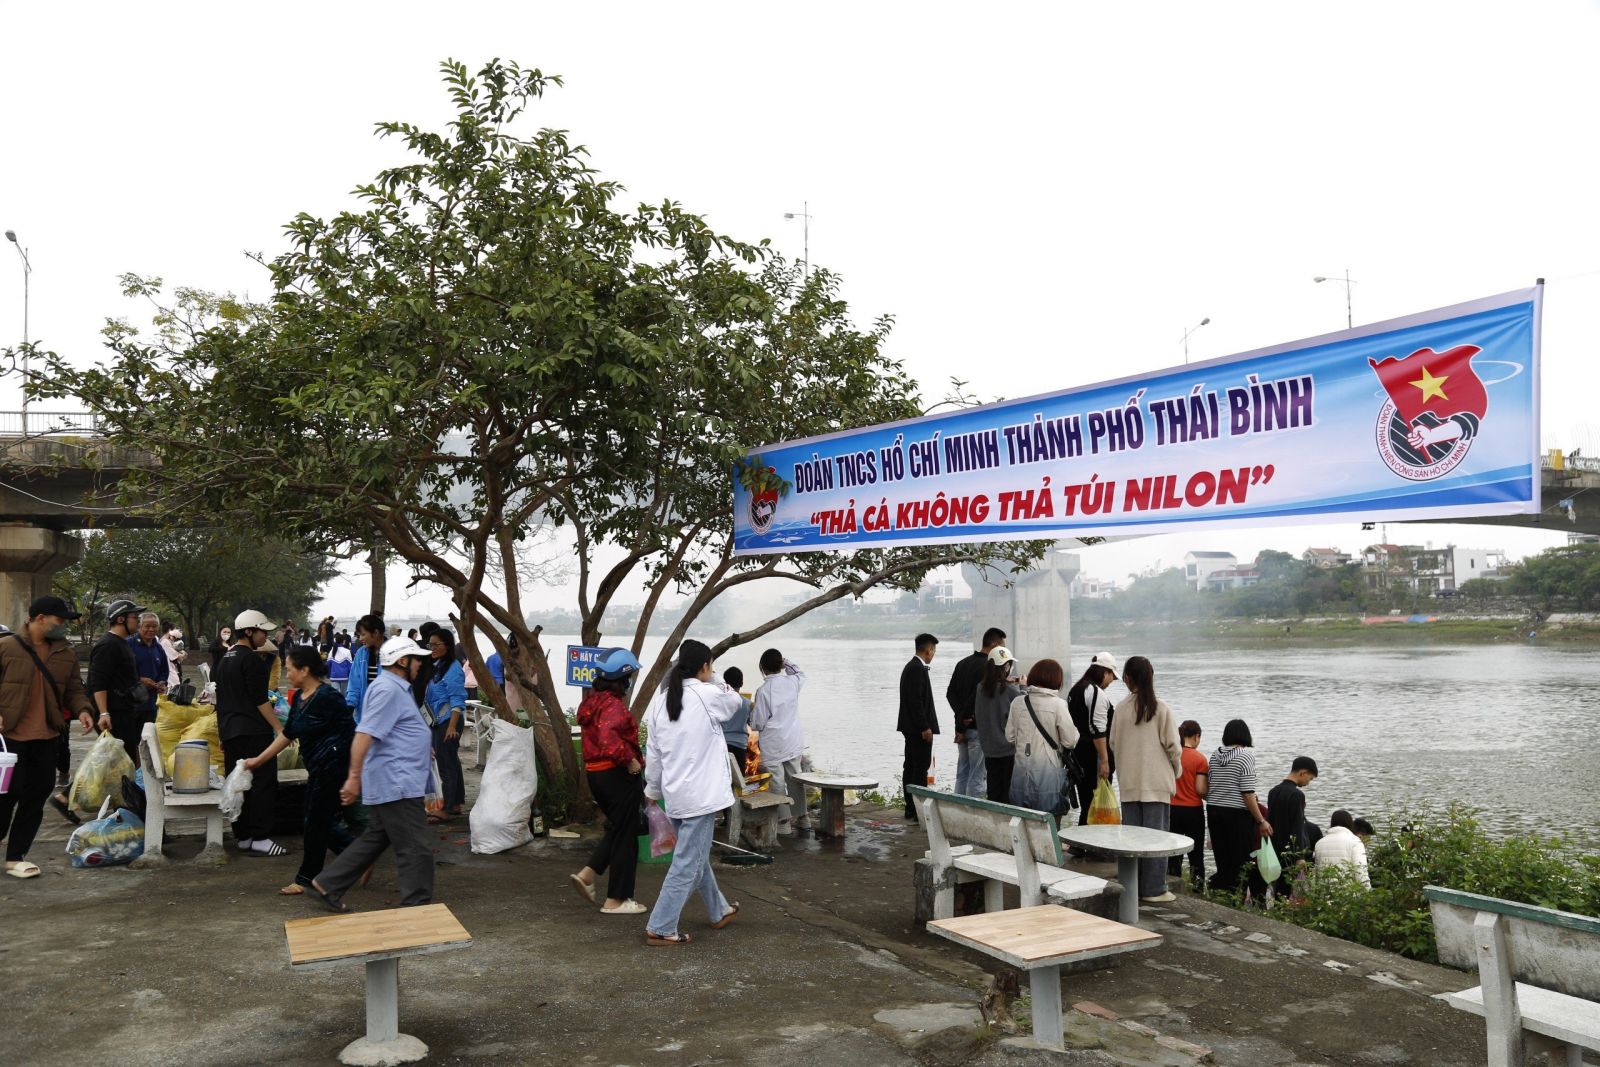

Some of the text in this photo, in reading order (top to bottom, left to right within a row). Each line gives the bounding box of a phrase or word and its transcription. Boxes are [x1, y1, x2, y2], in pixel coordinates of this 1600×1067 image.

[794, 454, 834, 494] ĐOÀN
[836, 451, 877, 487] TNCS
[909, 432, 941, 478] CHÍ
[945, 430, 1000, 473] MINH
[1004, 415, 1083, 465] THÀNH
[1088, 390, 1144, 454] PHỐ
[1150, 386, 1219, 446] THÁI
[1228, 376, 1313, 436] BÌNH
[863, 498, 889, 533] CÁ
[896, 492, 990, 530] KHÔNG
[998, 476, 1054, 522] THẢ
[1064, 473, 1115, 516] TÚI
[572, 665, 597, 683] RÁC
